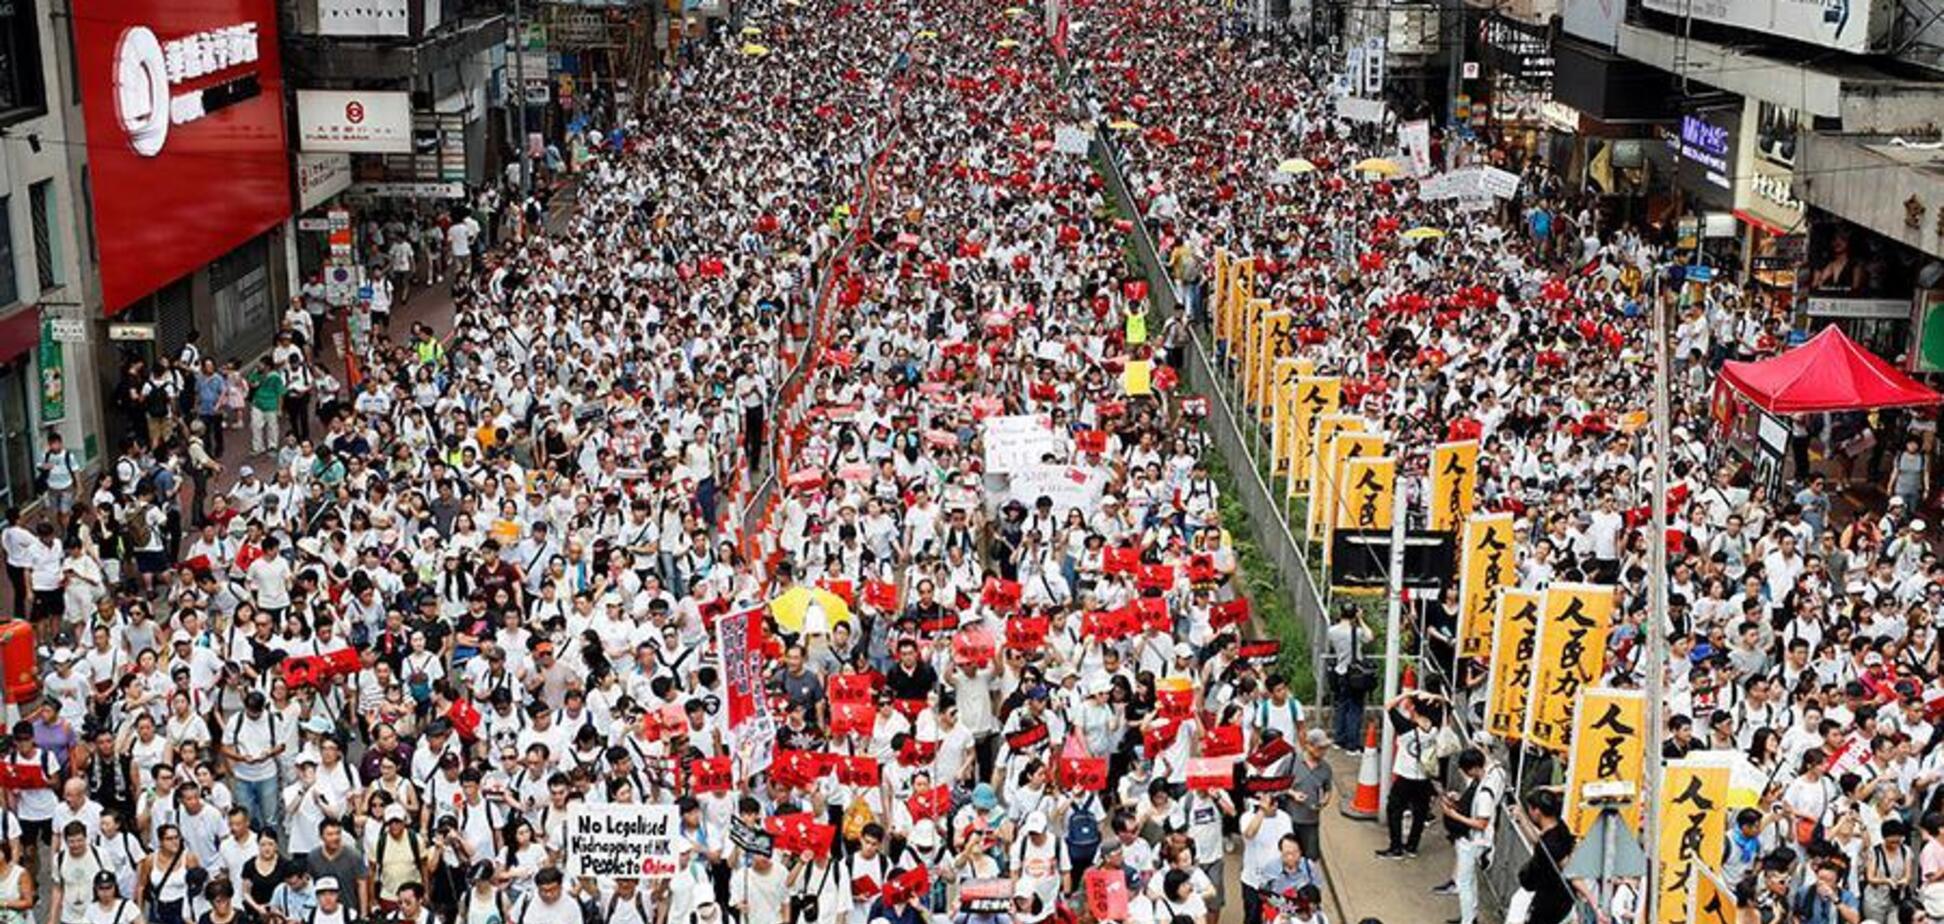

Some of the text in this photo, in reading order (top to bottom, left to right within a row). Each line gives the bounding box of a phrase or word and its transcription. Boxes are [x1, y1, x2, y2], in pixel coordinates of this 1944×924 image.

[1355, 467, 1385, 528] 人民
[1590, 702, 1634, 781] 人民
[578, 815, 668, 838] No Legalised
[571, 836, 671, 859] Kidnapping of HK
[581, 855, 676, 876] People to China
